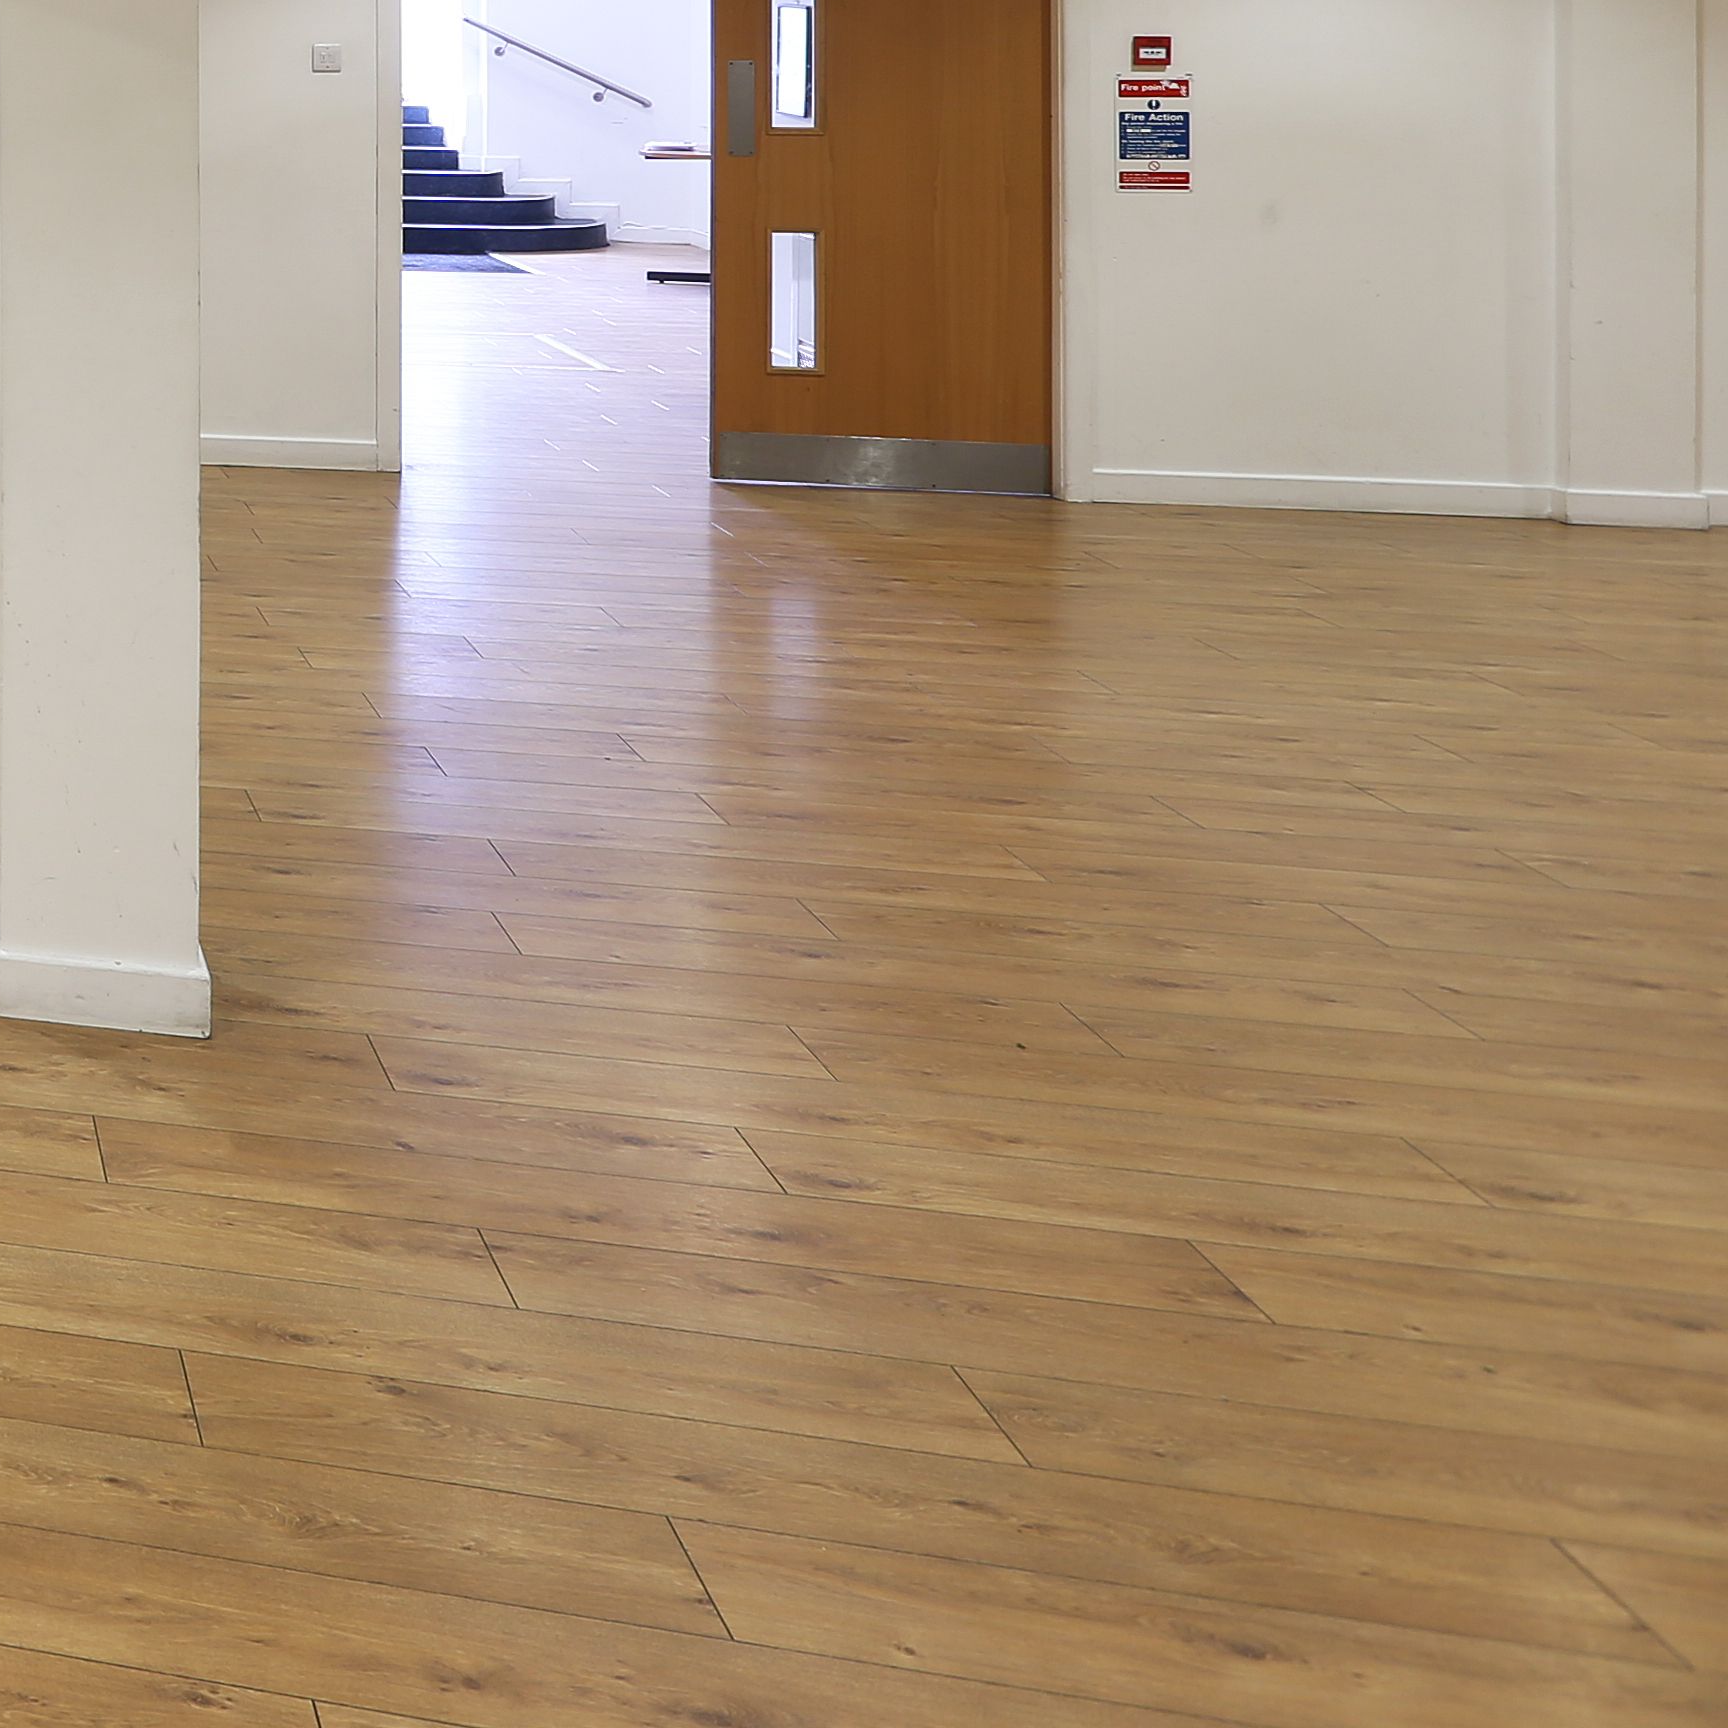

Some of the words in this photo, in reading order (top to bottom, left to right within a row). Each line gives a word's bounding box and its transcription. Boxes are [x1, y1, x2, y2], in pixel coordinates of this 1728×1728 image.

[1120, 83, 1139, 91] Fire
[1124, 113, 1145, 121] Fire
[1148, 113, 1184, 121] Action
